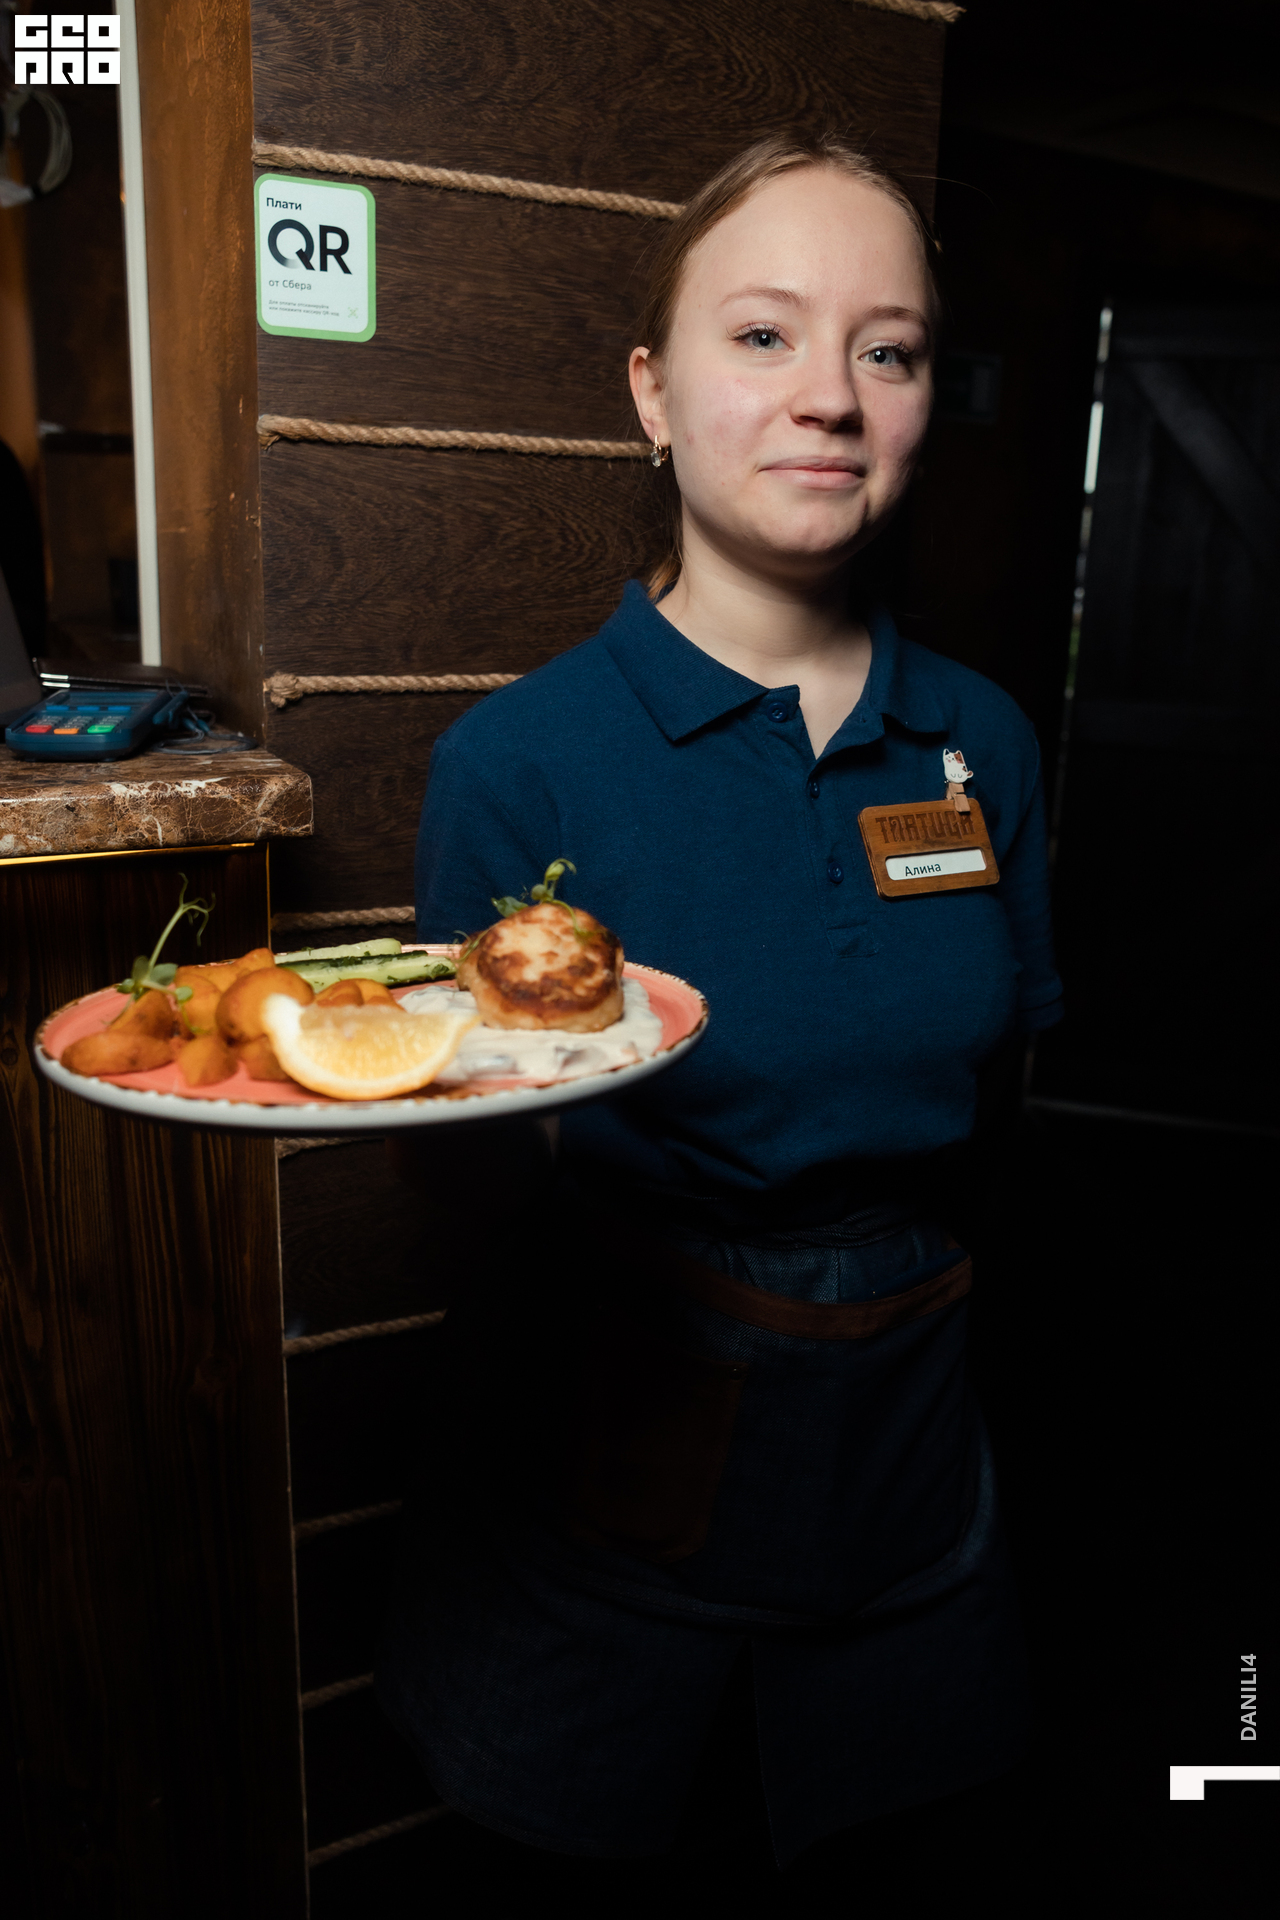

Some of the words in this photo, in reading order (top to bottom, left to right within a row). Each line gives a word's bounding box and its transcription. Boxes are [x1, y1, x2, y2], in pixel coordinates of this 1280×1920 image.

[266, 197, 302, 211] Плати
[267, 218, 353, 275] QR
[282, 279, 312, 291] Сбера
[905, 863, 942, 877] Алина
